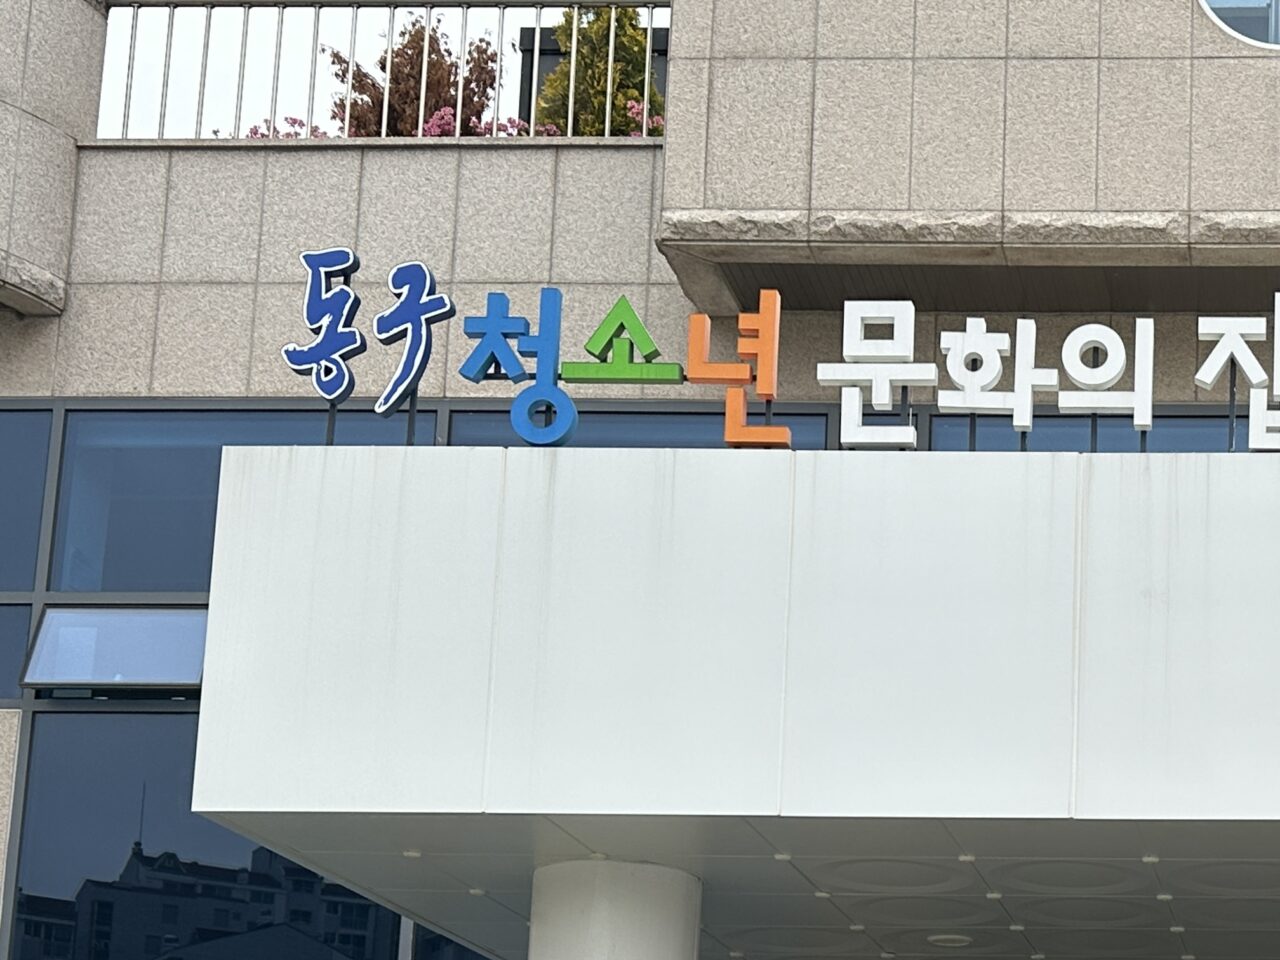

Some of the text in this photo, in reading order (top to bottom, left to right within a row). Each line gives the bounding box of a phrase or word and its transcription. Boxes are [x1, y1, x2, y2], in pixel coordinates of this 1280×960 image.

[282, 248, 456, 418] 동구
[458, 286, 792, 448] 청소년
[816, 299, 1154, 449] 문화의
